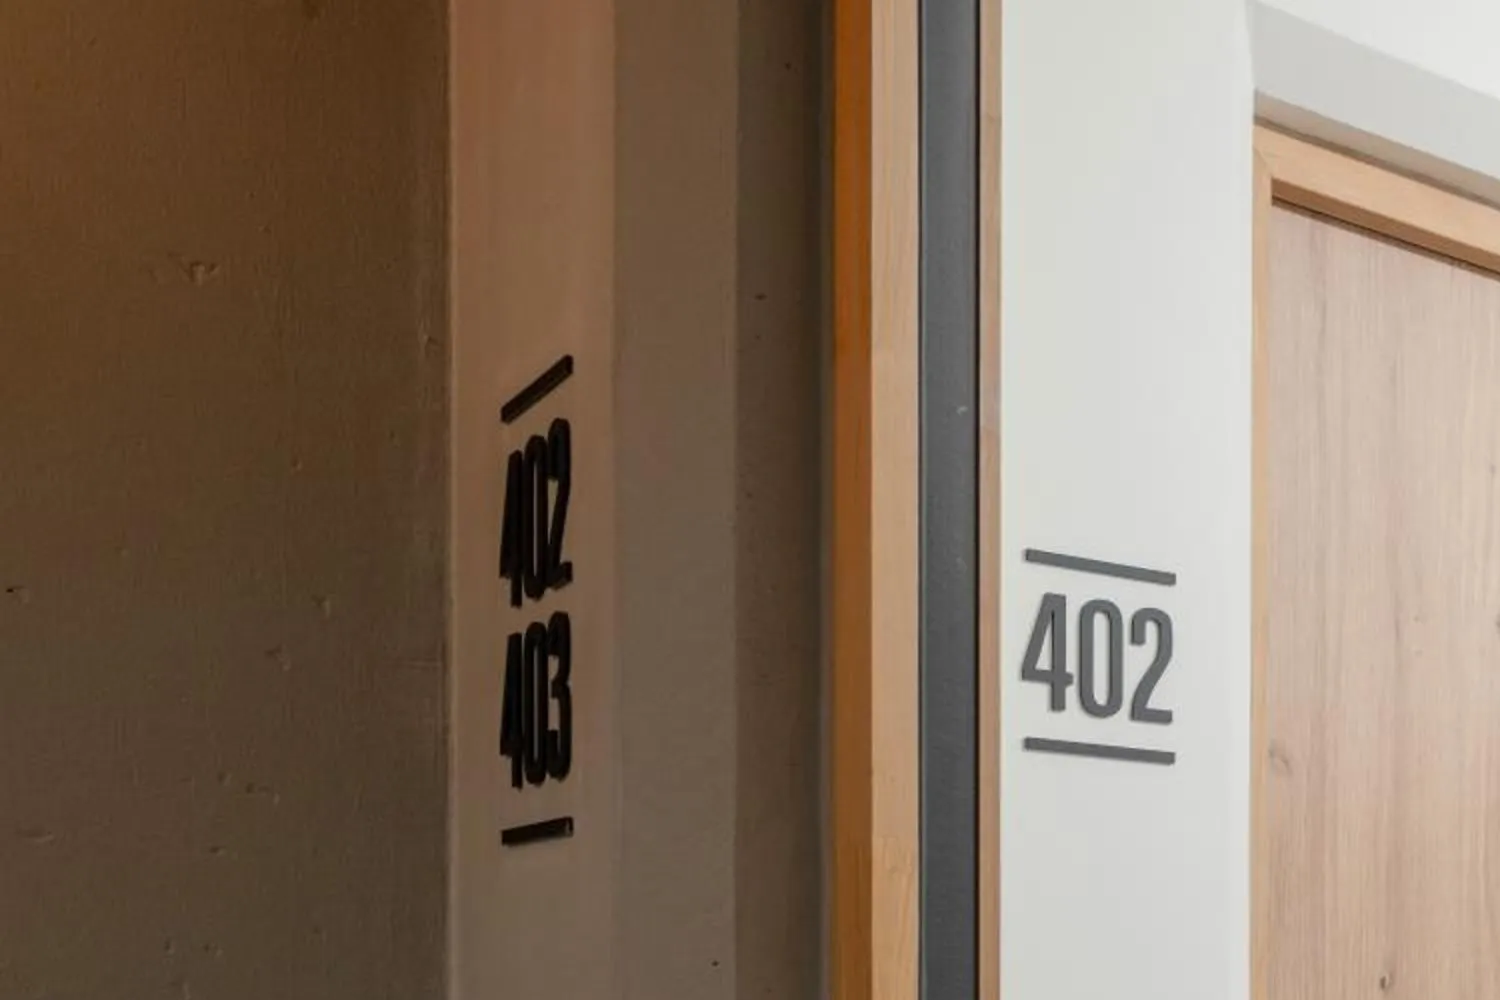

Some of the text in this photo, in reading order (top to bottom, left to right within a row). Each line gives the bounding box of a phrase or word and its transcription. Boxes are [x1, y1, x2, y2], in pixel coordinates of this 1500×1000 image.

[500, 417, 573, 608] 402
[500, 610, 573, 790] 403
[1020, 591, 1174, 726] 402
